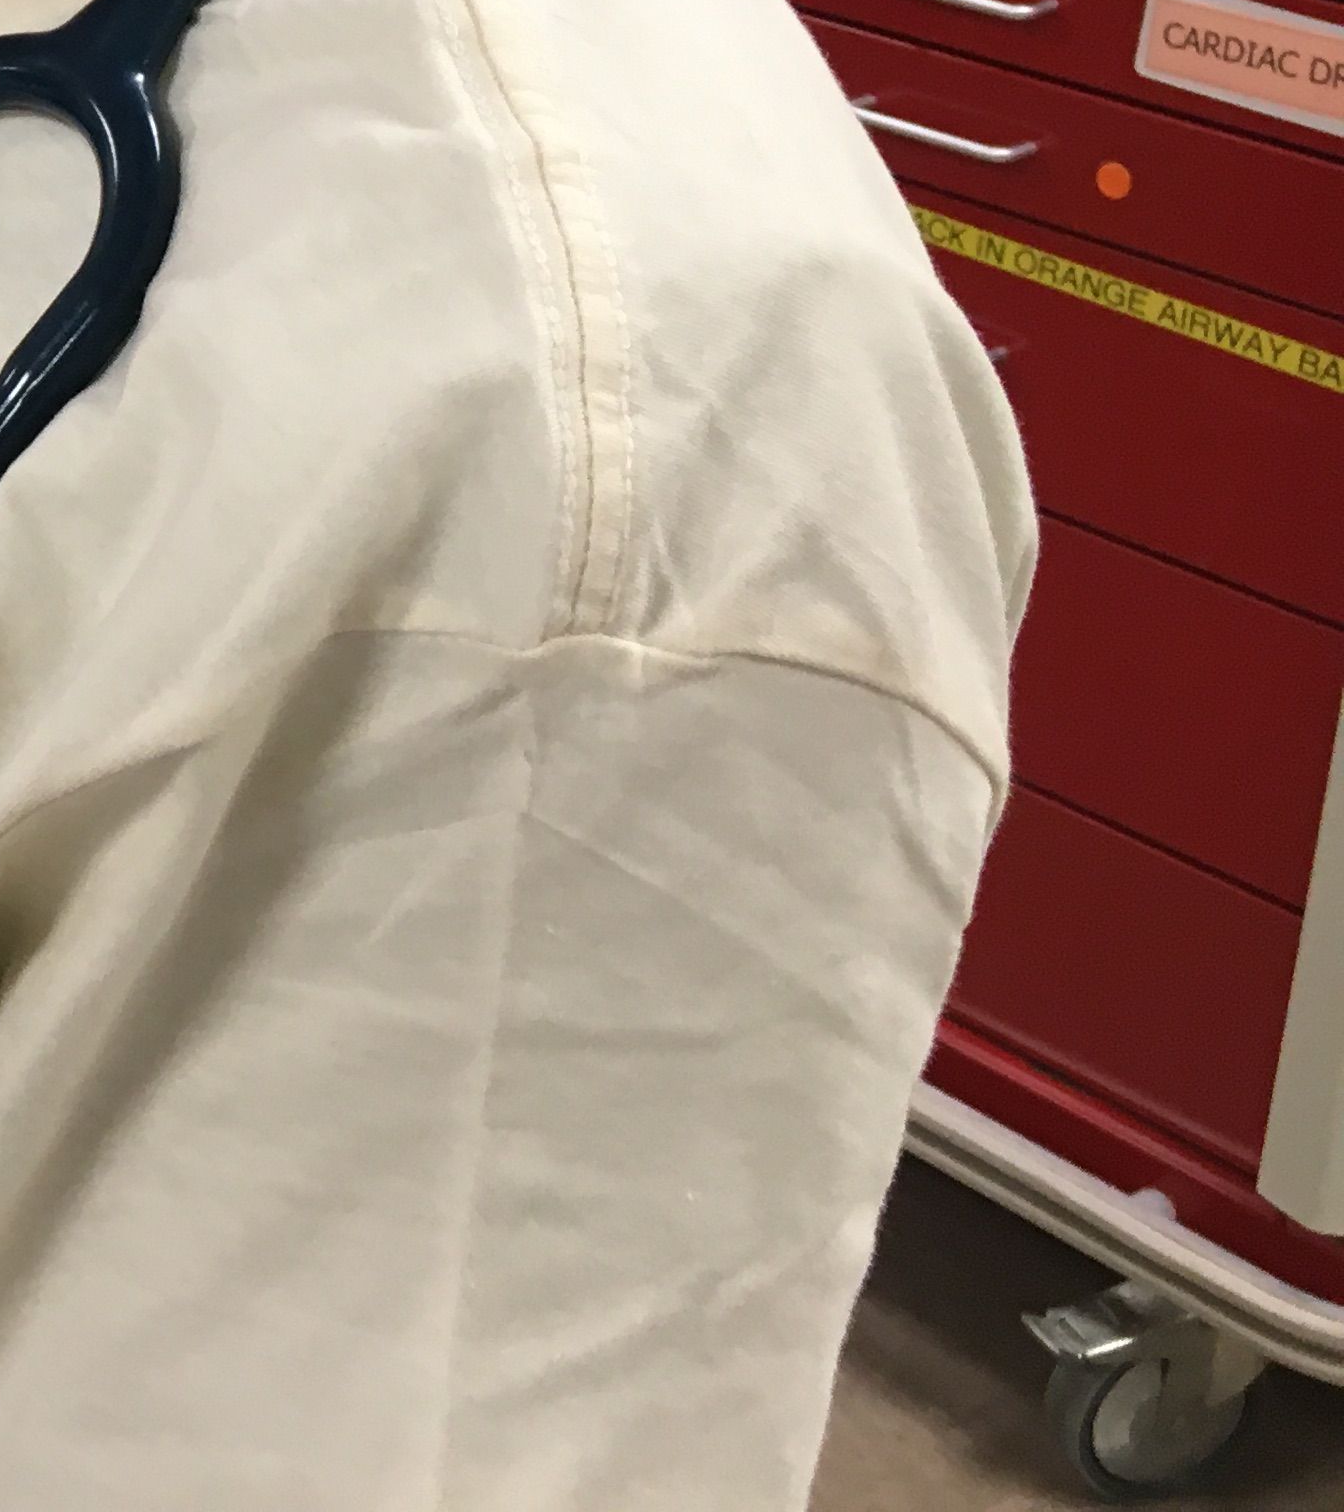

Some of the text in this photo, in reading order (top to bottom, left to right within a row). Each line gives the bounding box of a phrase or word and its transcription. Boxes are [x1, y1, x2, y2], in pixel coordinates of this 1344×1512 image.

[1163, 21, 1344, 88] CARDIAC DR
[913, 210, 1343, 388] ACK IN ORANGE AIRWAY BA
